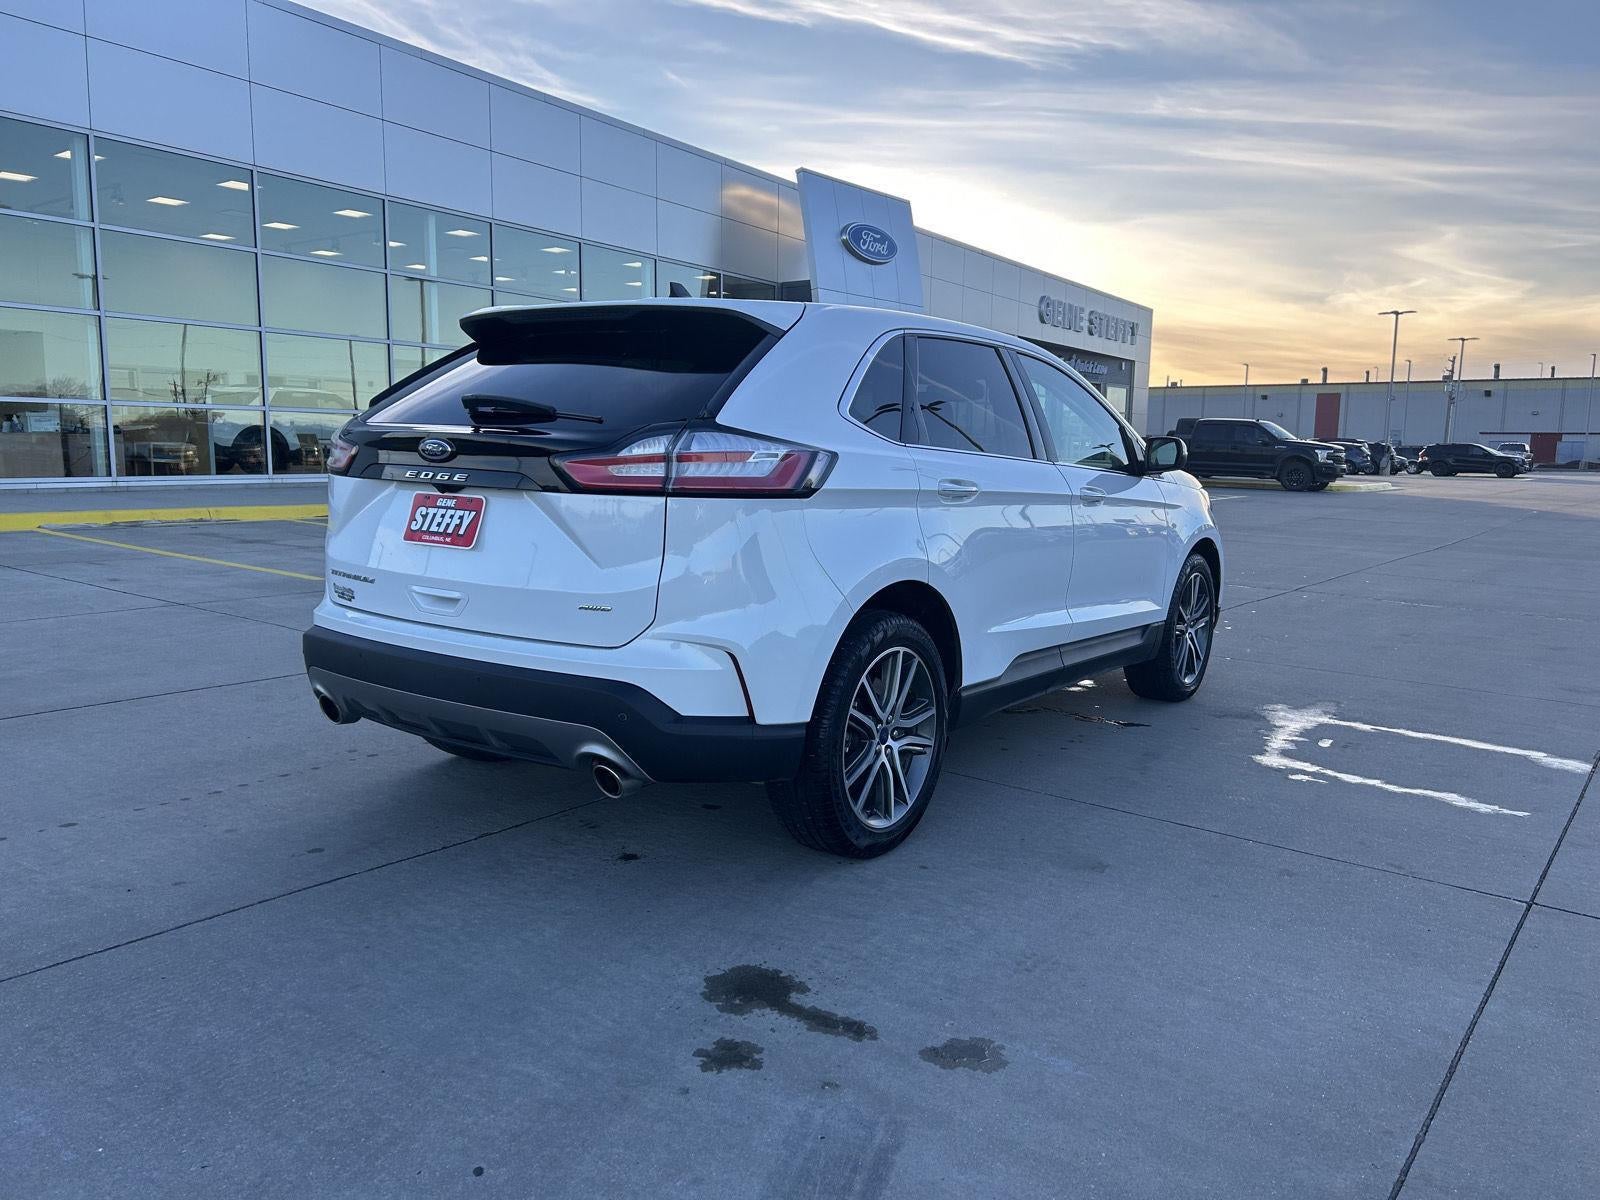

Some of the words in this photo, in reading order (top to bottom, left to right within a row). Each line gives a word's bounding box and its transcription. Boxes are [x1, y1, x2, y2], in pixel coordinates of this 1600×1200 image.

[860, 230, 888, 255] Ford
[1039, 295, 1084, 332] GENE
[1087, 310, 1139, 345] STEFFY
[425, 443, 444, 455] Ford
[405, 470, 469, 481] EDGE
[436, 498, 457, 507] GENE
[410, 506, 476, 535] STEFFY
